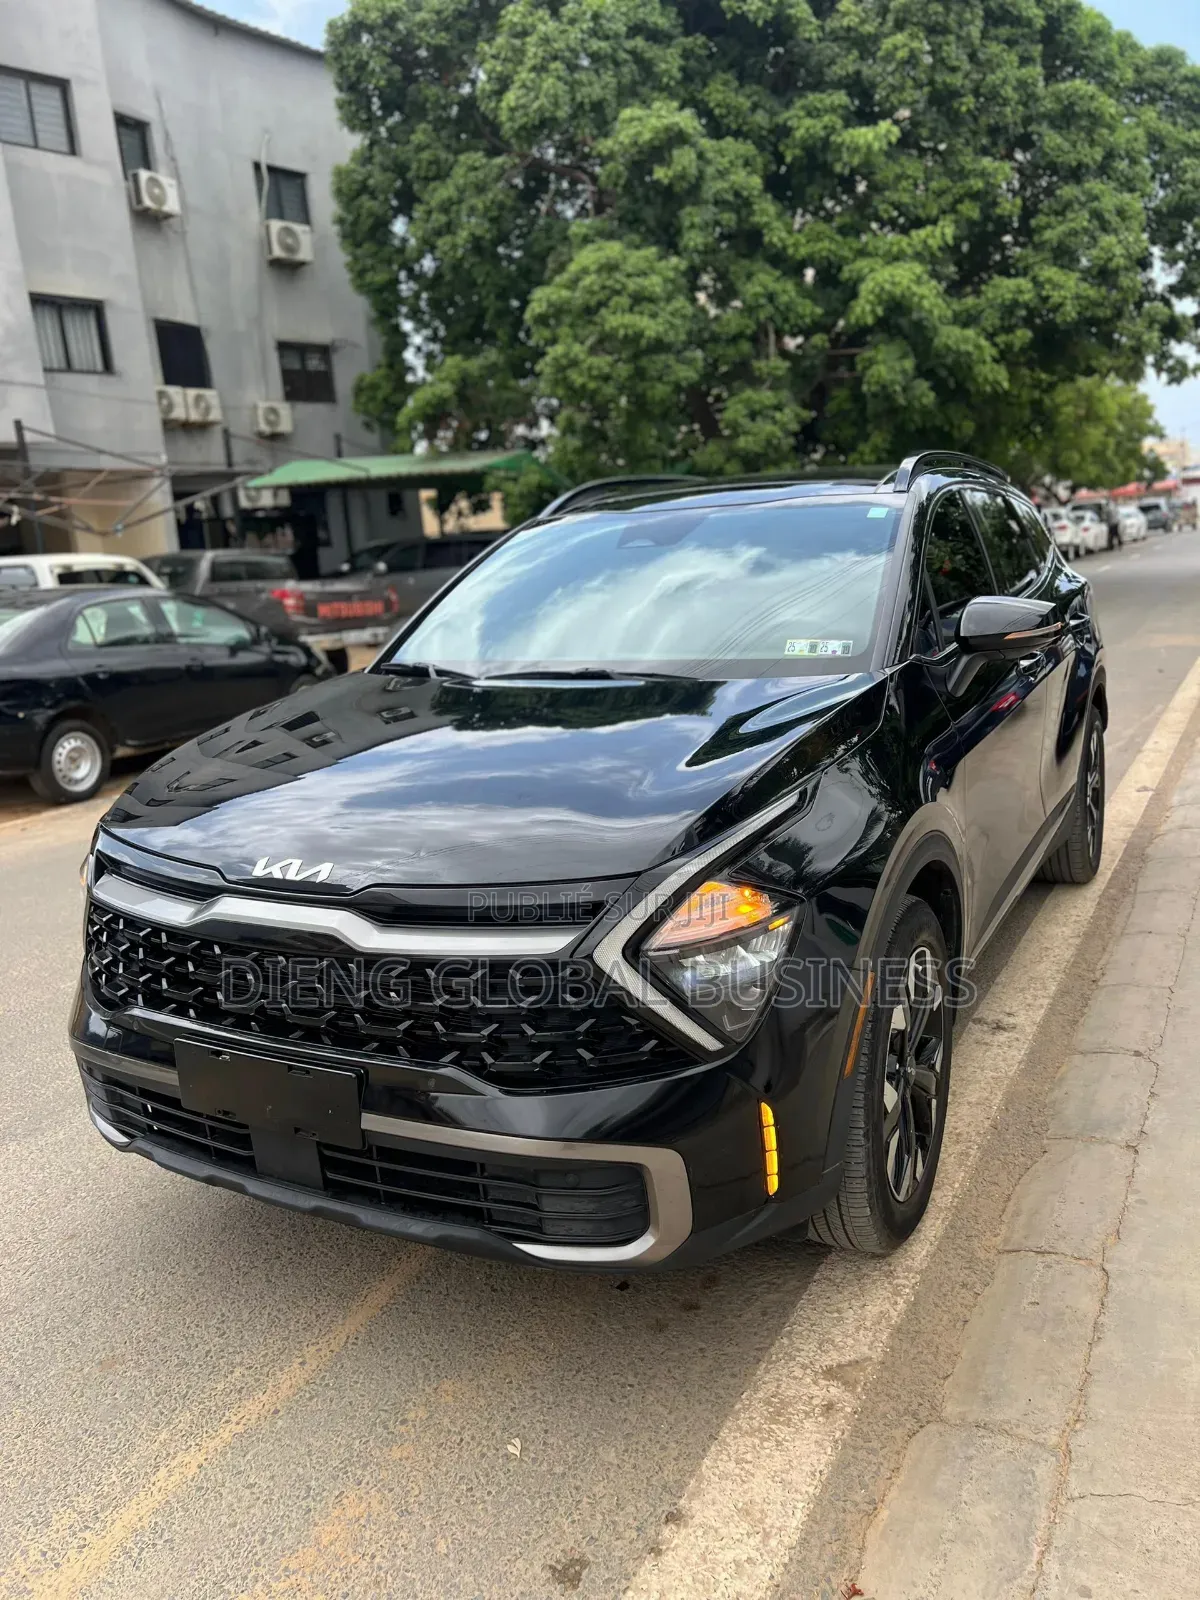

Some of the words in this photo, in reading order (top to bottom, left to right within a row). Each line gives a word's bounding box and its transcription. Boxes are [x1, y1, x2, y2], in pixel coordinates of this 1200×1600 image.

[787, 641, 796, 653] 25
[820, 641, 829, 653] 25
[252, 856, 334, 884] KIA
